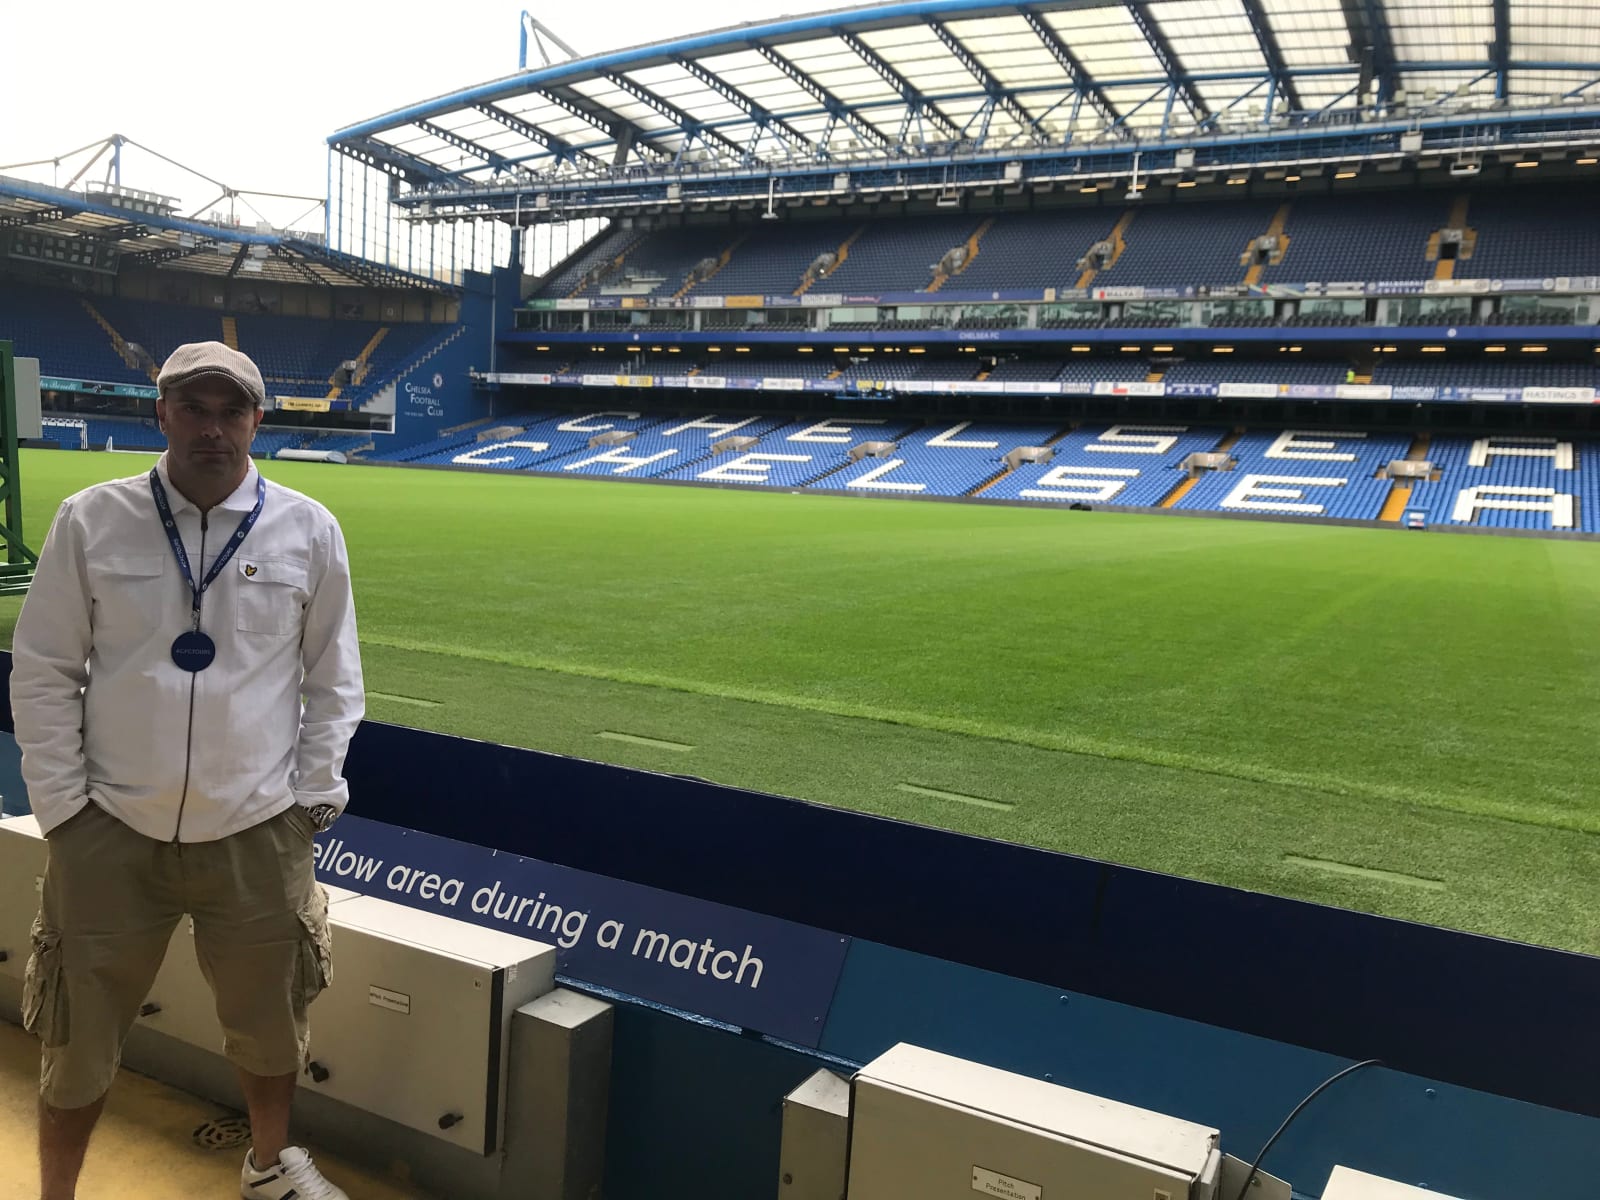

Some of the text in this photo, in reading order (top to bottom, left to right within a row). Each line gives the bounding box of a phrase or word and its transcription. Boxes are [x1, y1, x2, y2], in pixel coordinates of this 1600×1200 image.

[959, 331, 1000, 340] CHELSEA FC
[405, 382, 431, 394] CHELSEA
[410, 393, 440, 406] FOOTBALL
[1525, 390, 1577, 400] HASTINGS
[427, 405, 444, 417] CLUB
[557, 411, 1574, 471] CHELSEA
[452, 440, 1574, 529] CHELSEA
[312, 838, 765, 990] ellow area during a match
[998, 1178, 1015, 1189] Pitch
[985, 1182, 1026, 1200] Presentation
